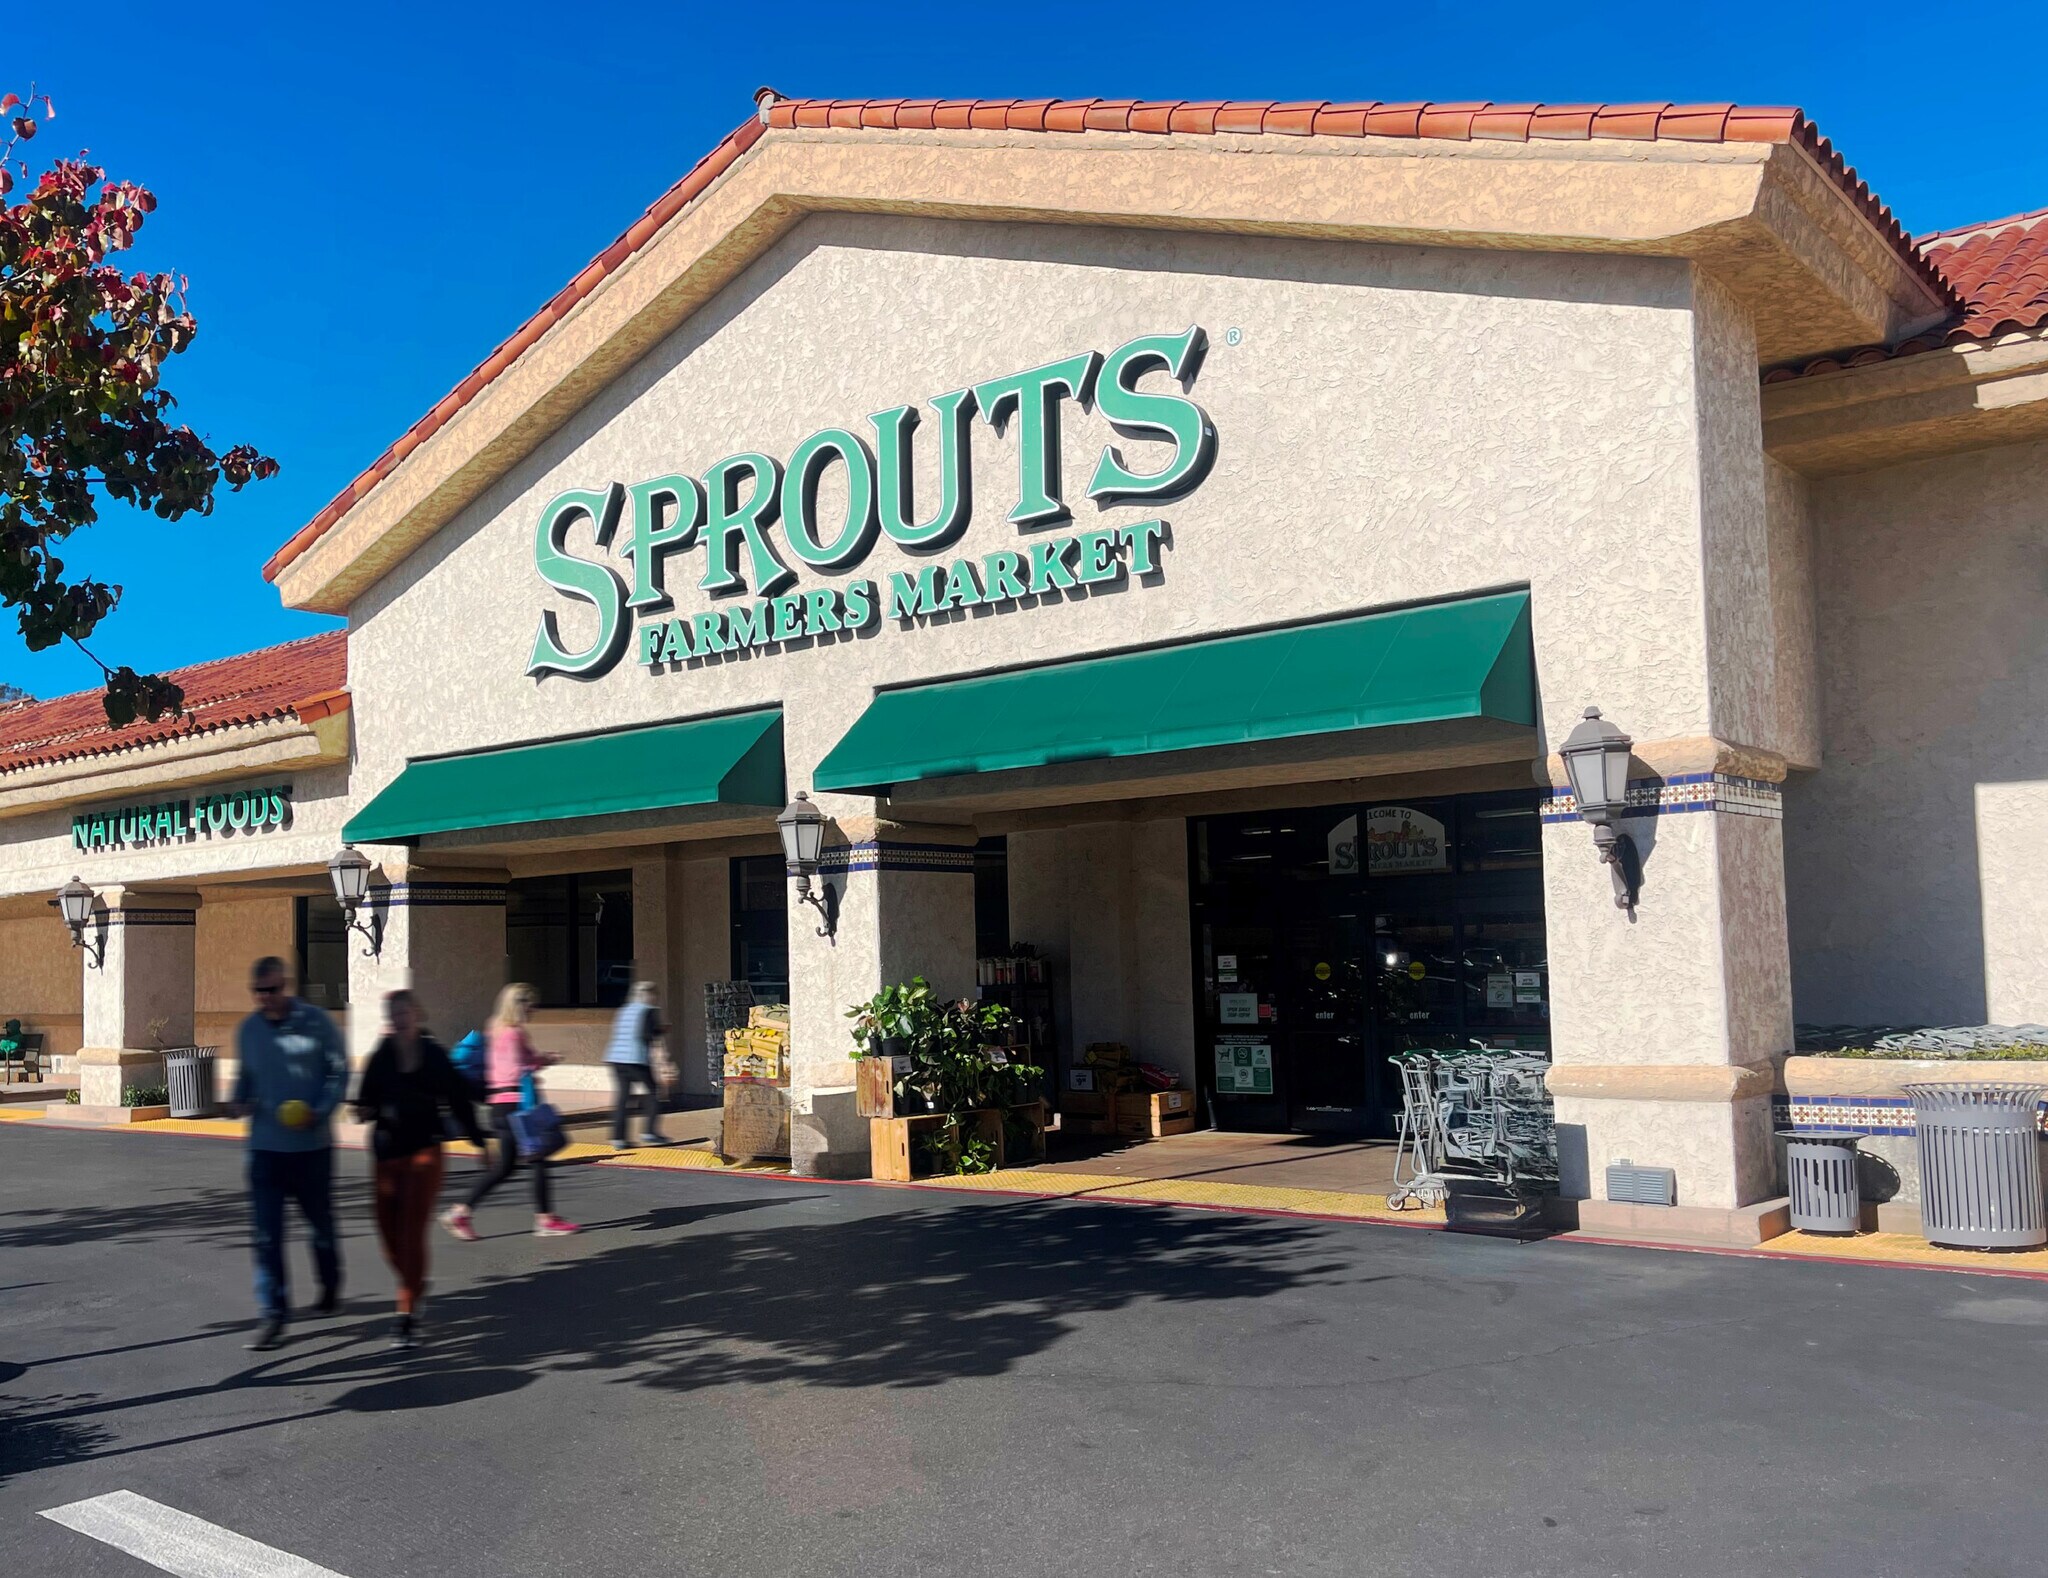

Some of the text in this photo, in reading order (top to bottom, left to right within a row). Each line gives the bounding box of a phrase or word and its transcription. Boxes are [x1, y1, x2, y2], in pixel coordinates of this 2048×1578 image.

[525, 324, 1216, 679] SPROUTS
[638, 519, 1168, 668] FARMERS MARKET
[72, 785, 286, 849] NATURAL FOODS
[1368, 809, 1412, 820] LCOME TO
[1315, 1010, 1335, 1020] enter
[1409, 1010, 1430, 1020] enter
